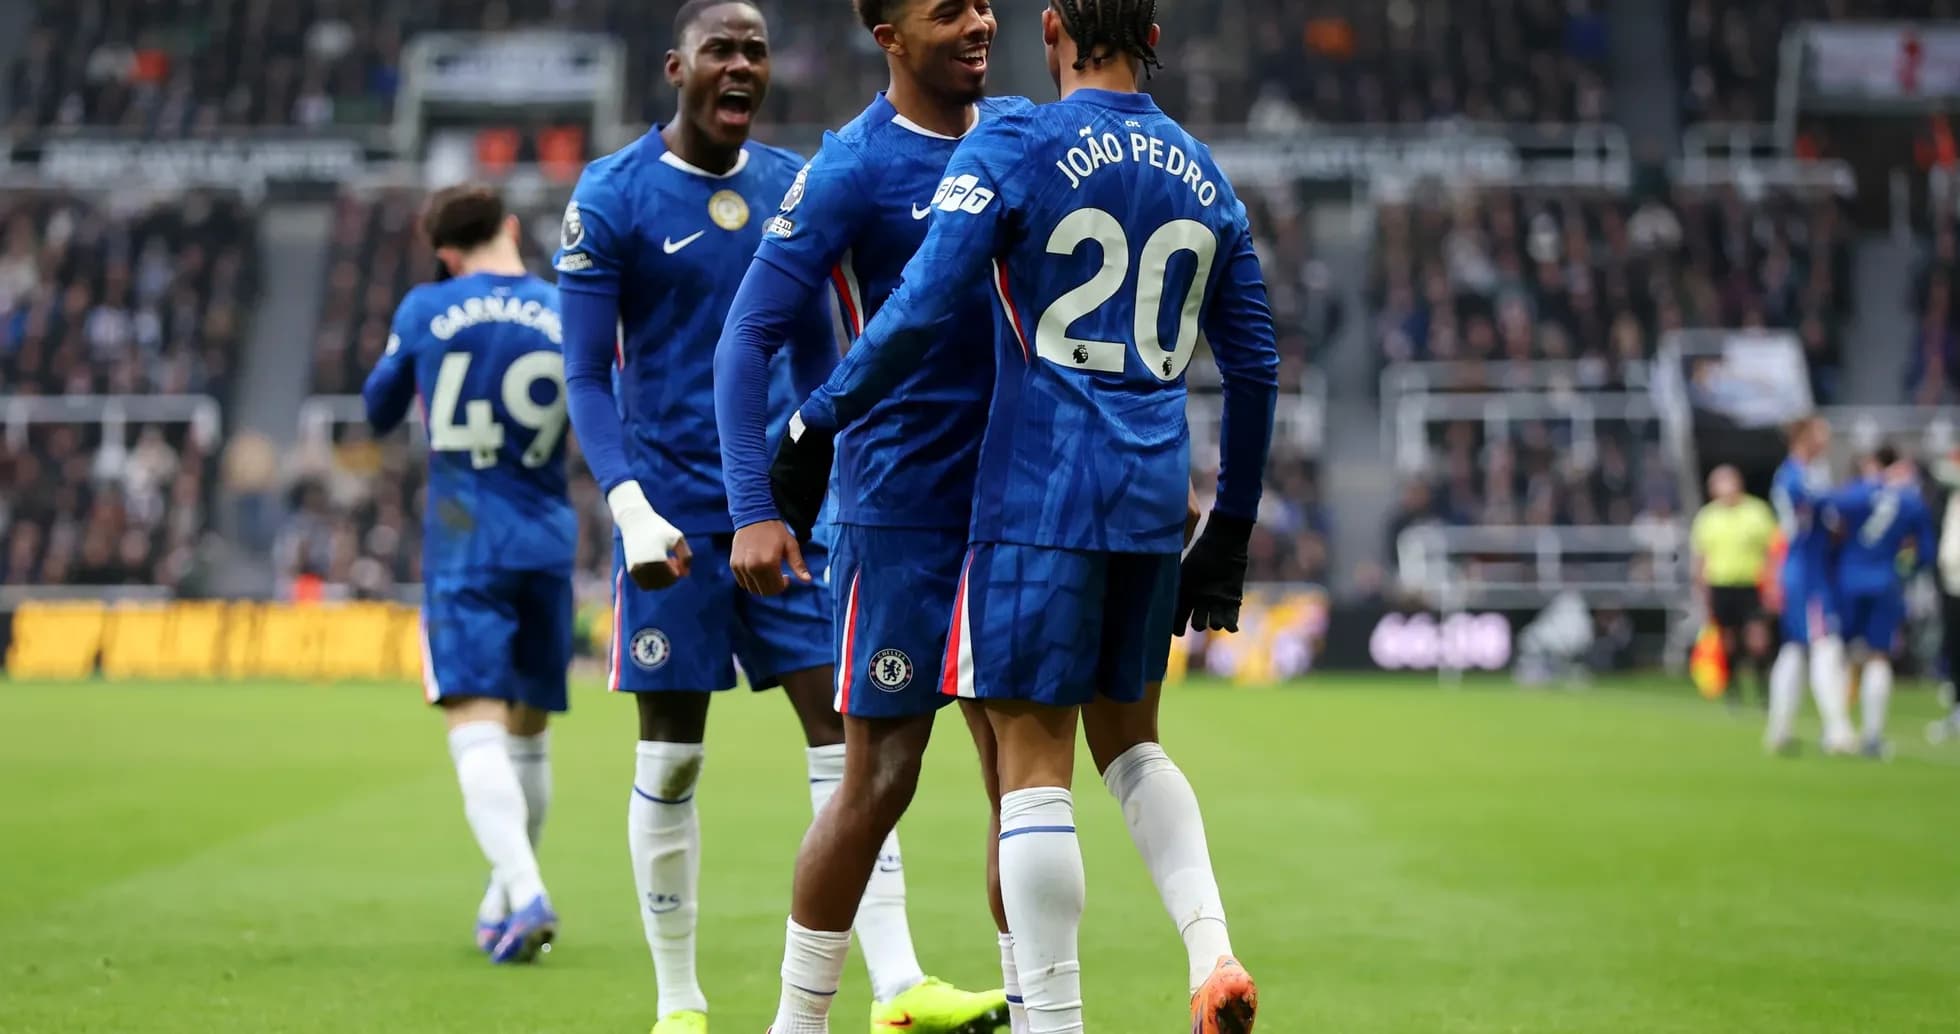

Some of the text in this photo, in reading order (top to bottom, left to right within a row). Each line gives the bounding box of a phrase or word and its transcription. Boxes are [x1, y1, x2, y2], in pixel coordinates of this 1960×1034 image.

[1056, 126, 1123, 189] JOÃO
[1130, 133, 1216, 207] PEDRO
[1035, 207, 1217, 382] 20
[430, 350, 569, 470] 49
